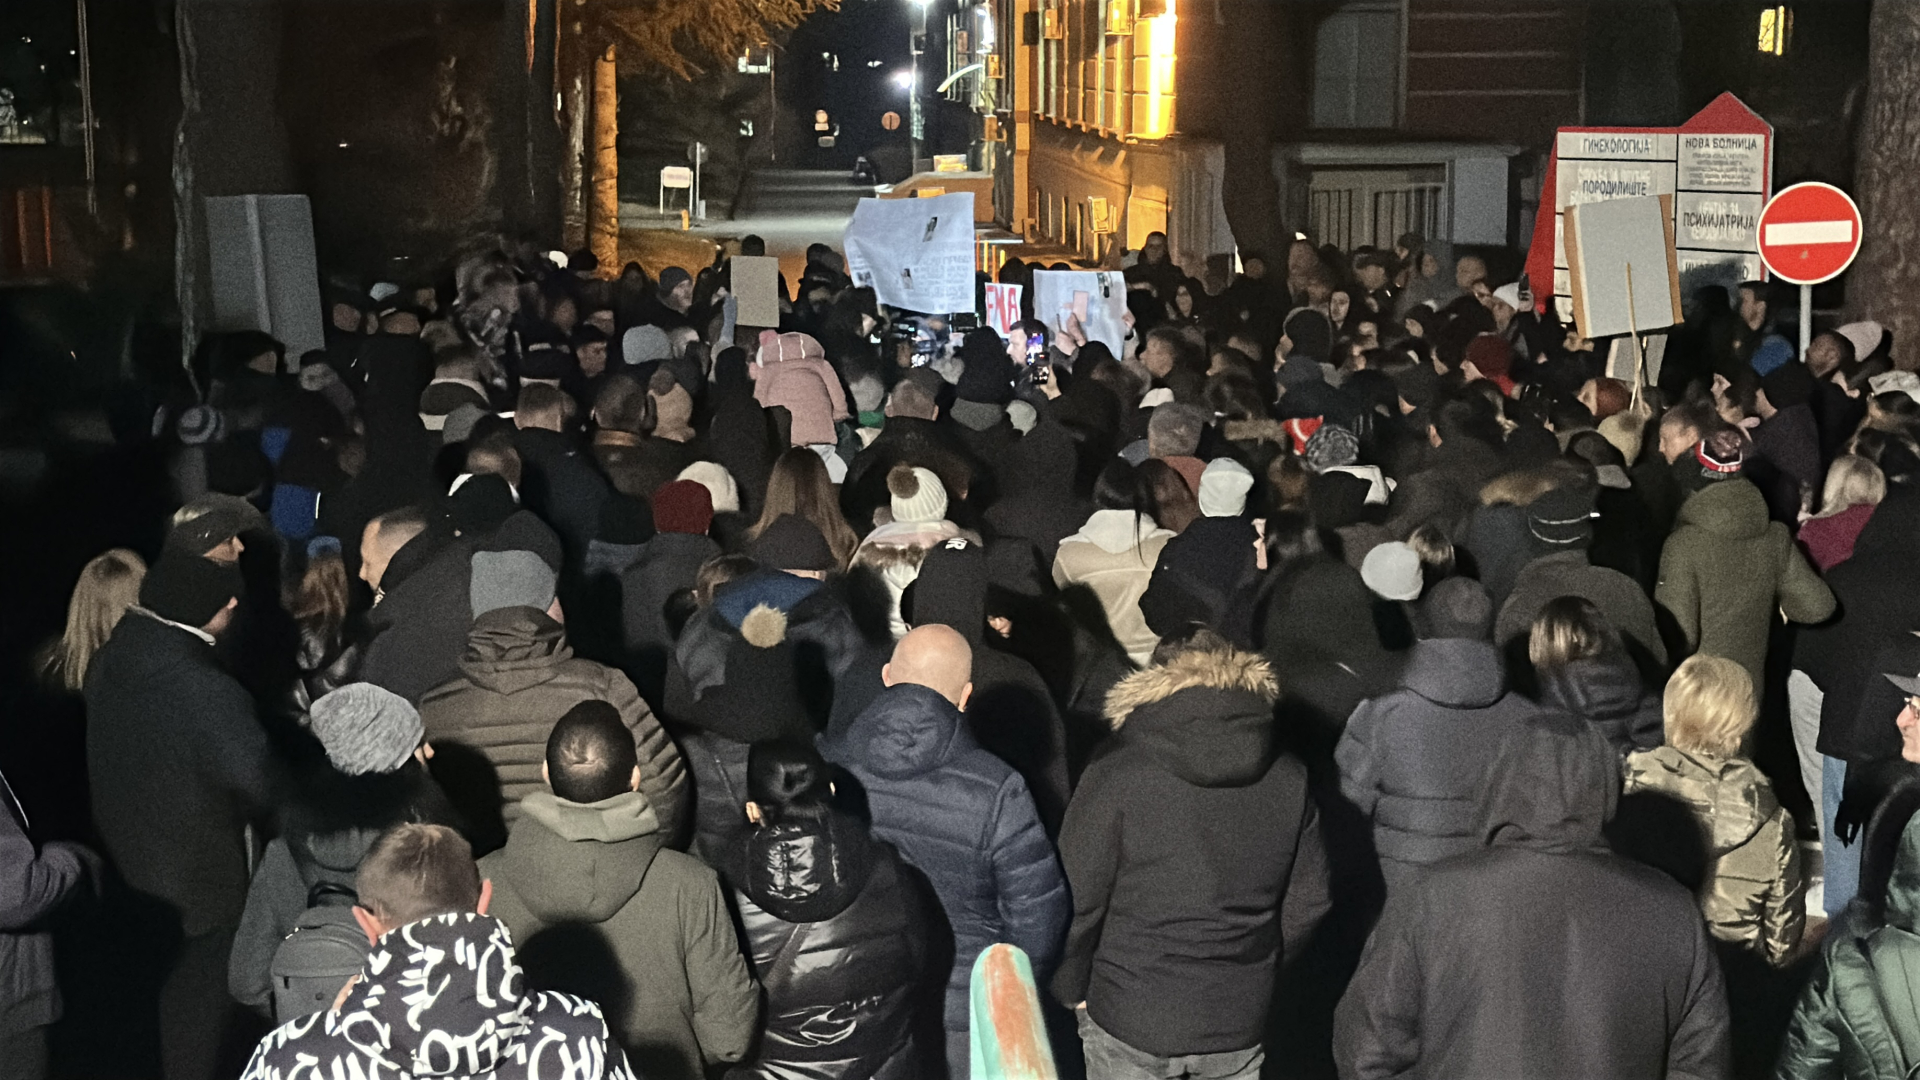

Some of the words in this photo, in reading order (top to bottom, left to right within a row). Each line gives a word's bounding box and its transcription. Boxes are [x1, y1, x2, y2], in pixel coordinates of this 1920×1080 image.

[1583, 137, 1651, 154] ГИНЕКОЛОГИЈА
[1685, 137, 1710, 149] НОВА
[1712, 138, 1757, 151] БОЛНИЦА
[1582, 180, 1647, 196] ПОРОДИЛИШТЕ
[1683, 212, 1754, 230] ПСИХИЈАТРИЈА
